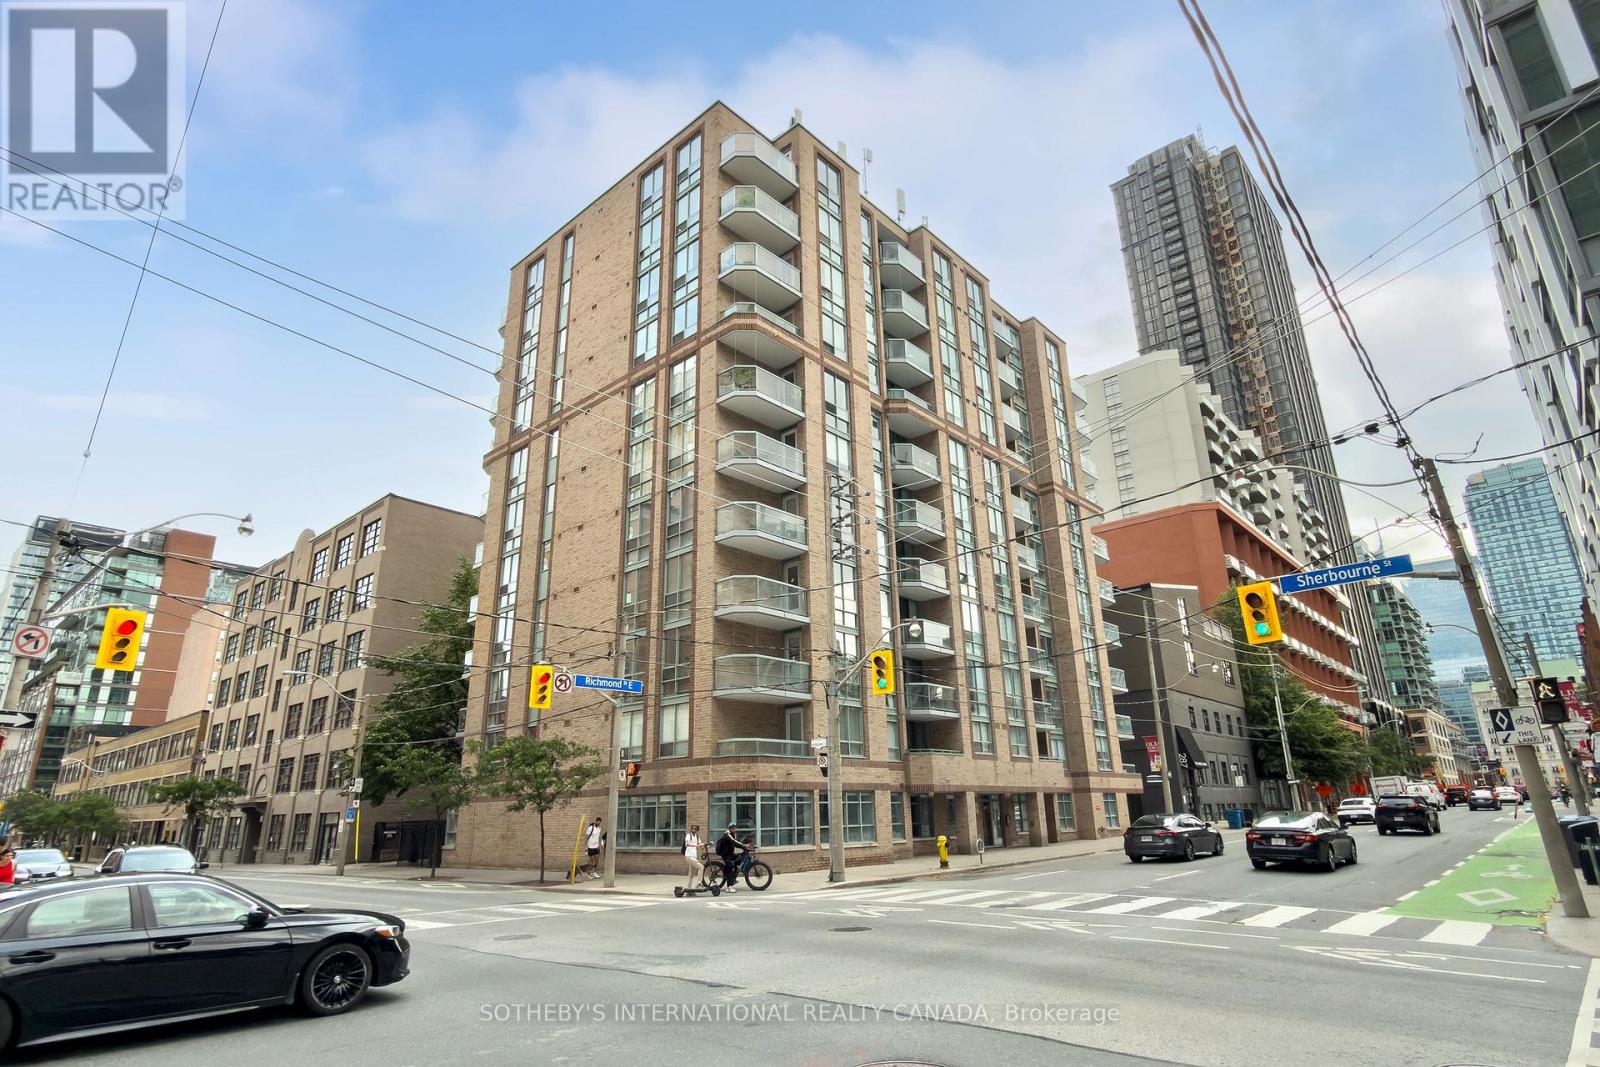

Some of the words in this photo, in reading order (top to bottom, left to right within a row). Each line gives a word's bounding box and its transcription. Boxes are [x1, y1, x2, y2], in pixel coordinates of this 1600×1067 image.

[1296, 563, 1381, 588] Sherbourne
[1383, 560, 1392, 568] St
[585, 677, 622, 689] Richmond
[1178, 753, 1189, 769] 287
